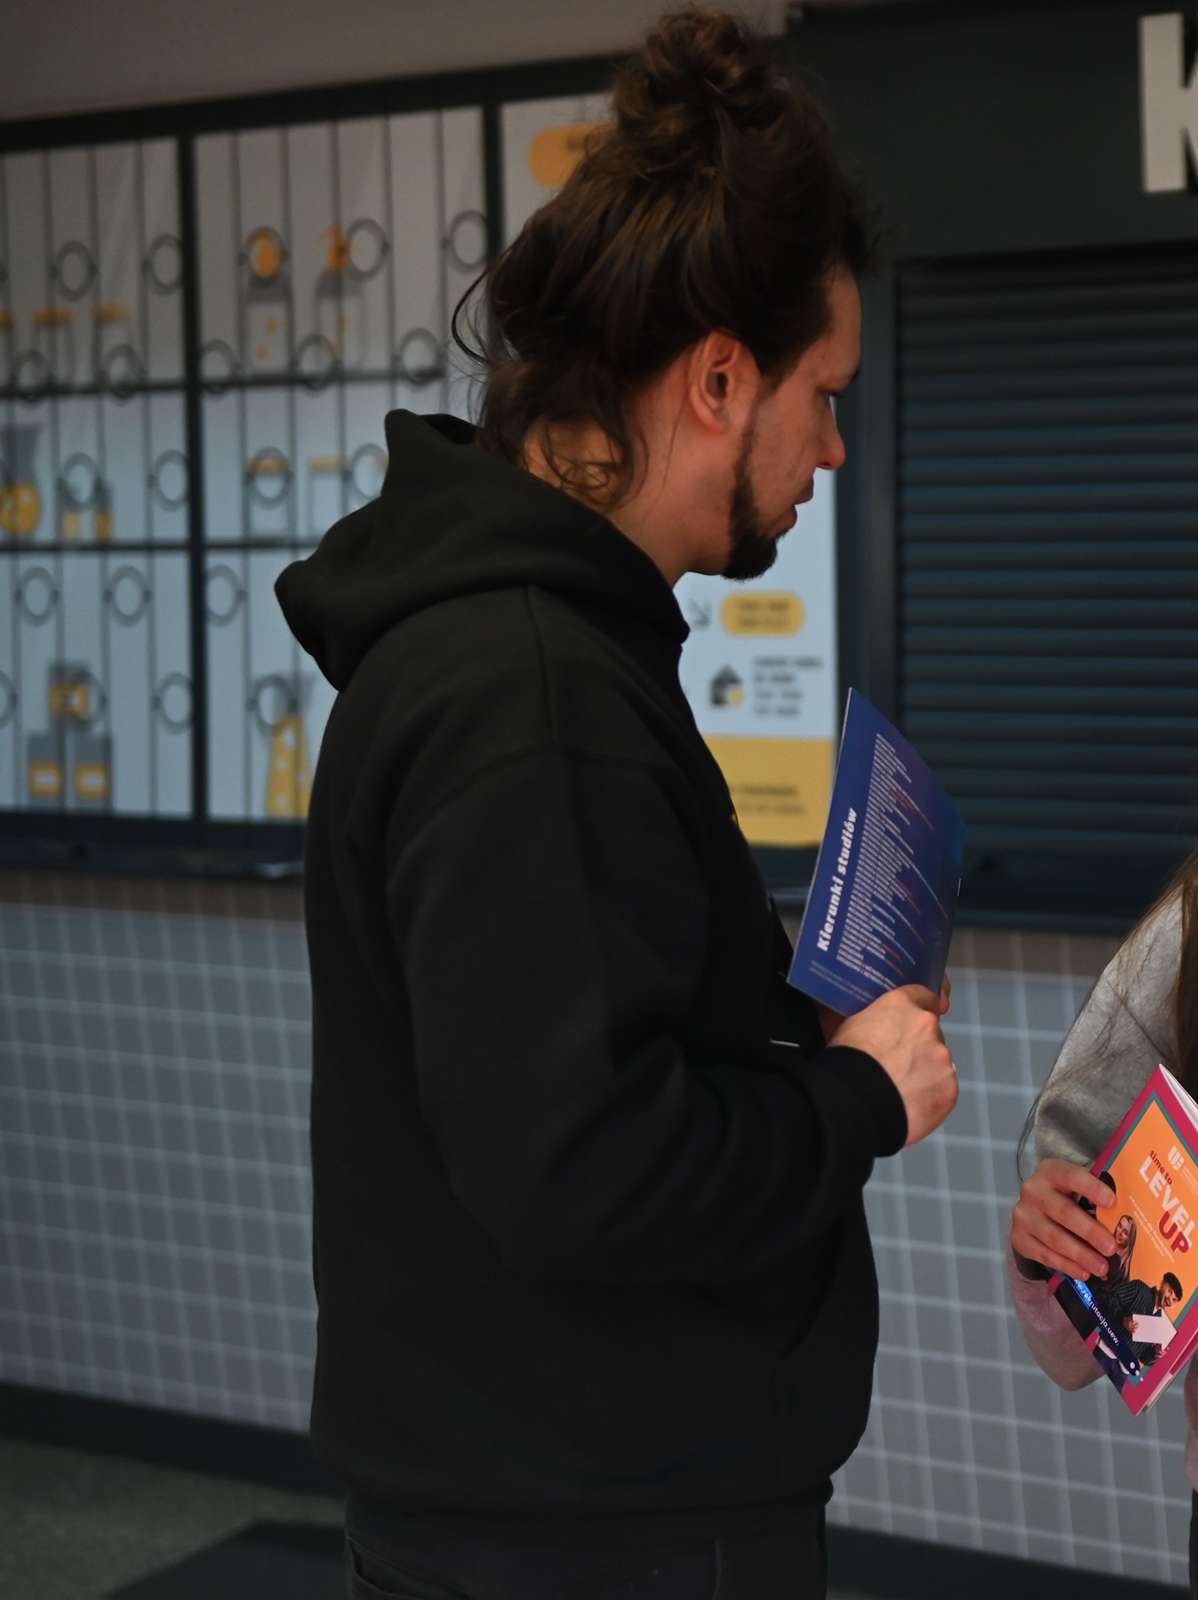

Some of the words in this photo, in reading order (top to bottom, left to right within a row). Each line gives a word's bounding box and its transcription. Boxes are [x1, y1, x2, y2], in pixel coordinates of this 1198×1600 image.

[817, 876, 844, 951] Kierunki
[838, 808, 857, 875] studiów
[1139, 1155, 1196, 1248] LEVEL
[1159, 1211, 1189, 1253] UP
